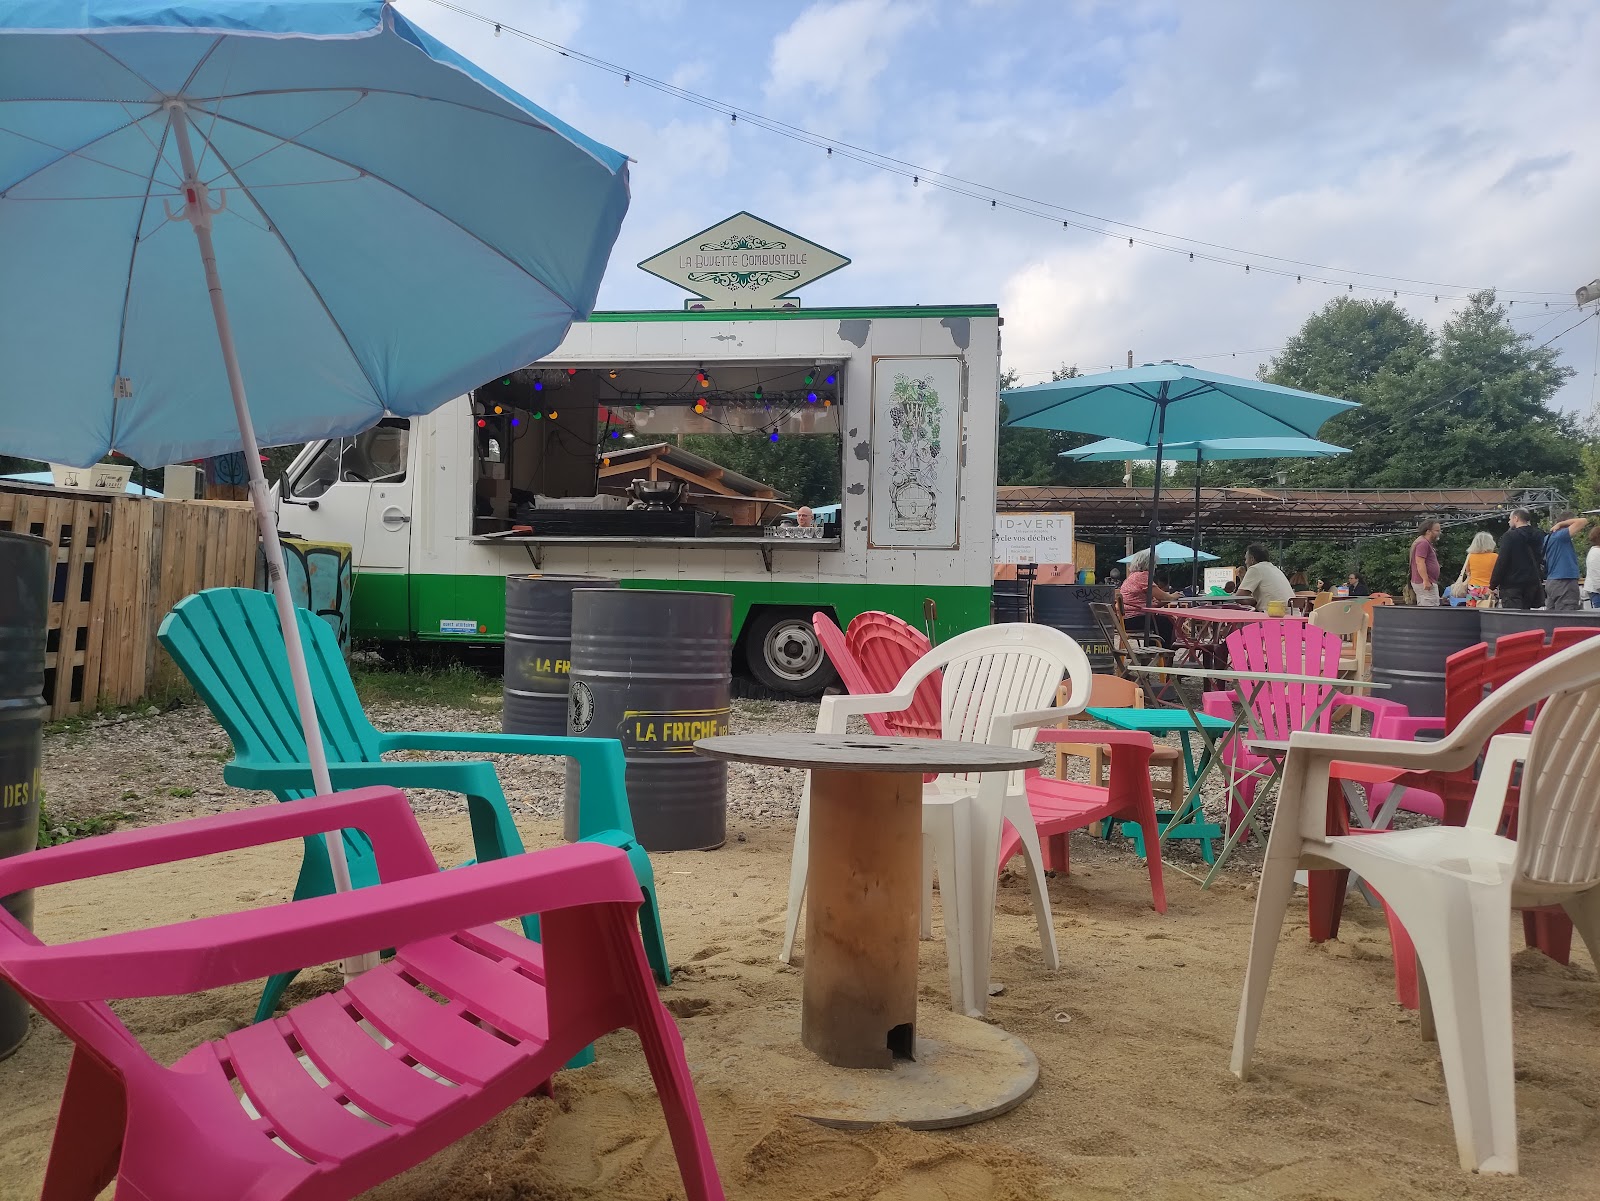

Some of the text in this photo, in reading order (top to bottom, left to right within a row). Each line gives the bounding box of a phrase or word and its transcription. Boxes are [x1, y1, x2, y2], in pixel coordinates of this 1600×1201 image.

[679, 253, 807, 268] LA BUVETTE COMBUSTIBLE
[1027, 533, 1057, 541] déchets
[1093, 644, 1111, 654] FRIC
[536, 657, 551, 672] LA
[636, 722, 657, 741] LA
[663, 720, 717, 741] FRICHE
[3, 782, 29, 808] DES
